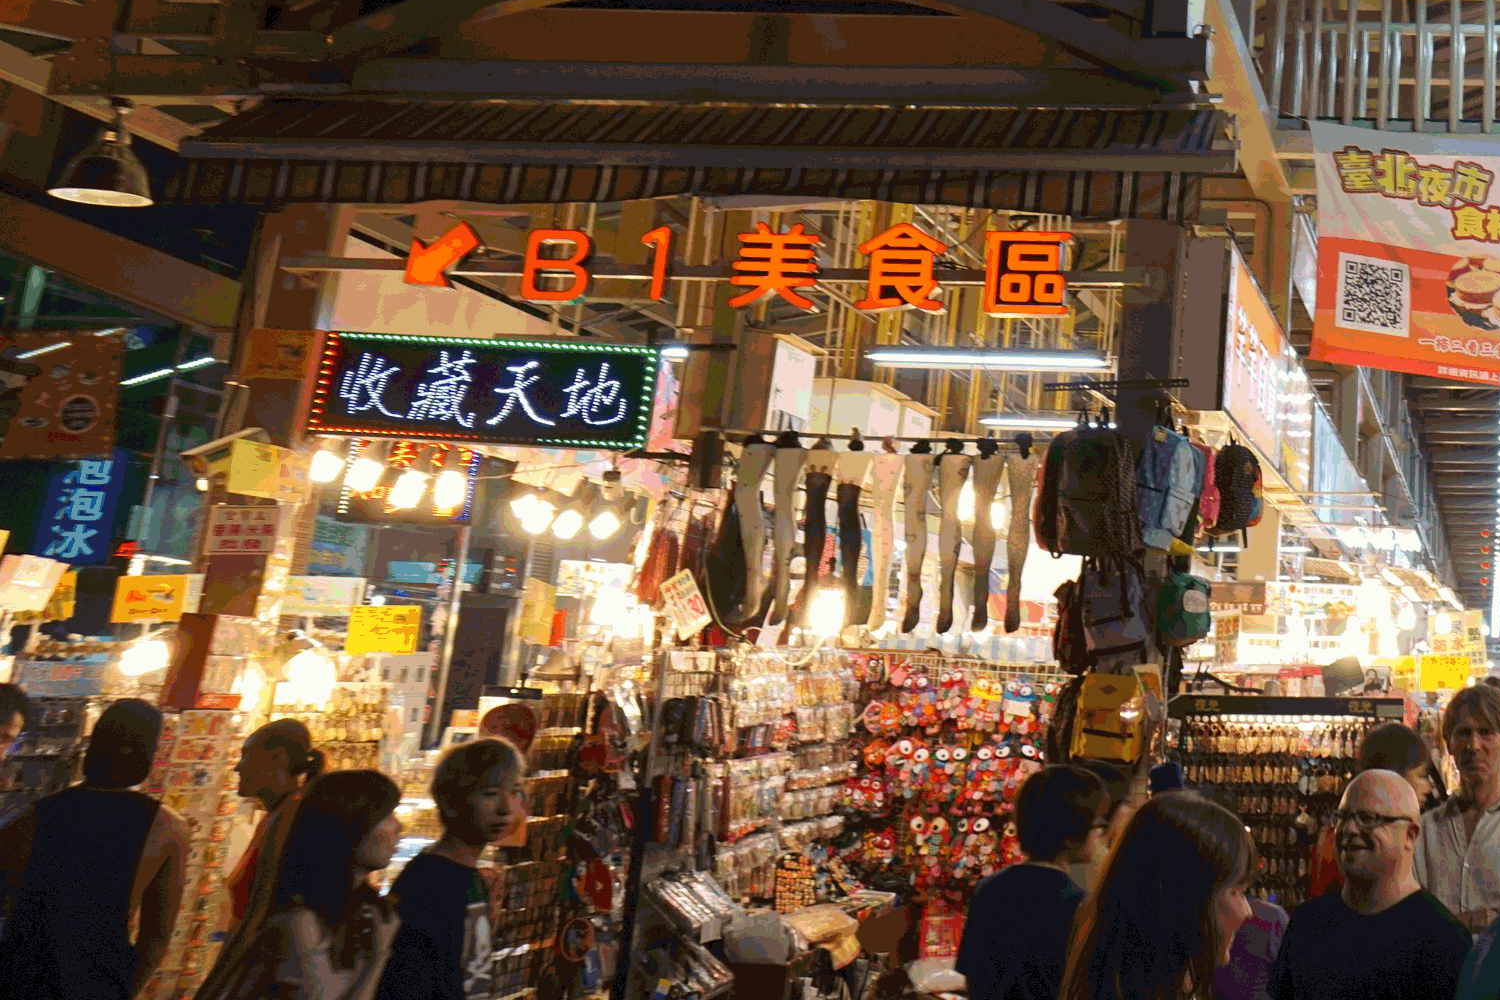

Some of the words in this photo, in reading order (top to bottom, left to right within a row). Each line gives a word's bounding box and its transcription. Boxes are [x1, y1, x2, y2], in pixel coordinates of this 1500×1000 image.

[1333, 145, 1494, 209] 臺北夜市
[338, 350, 627, 429] 收藏天地
